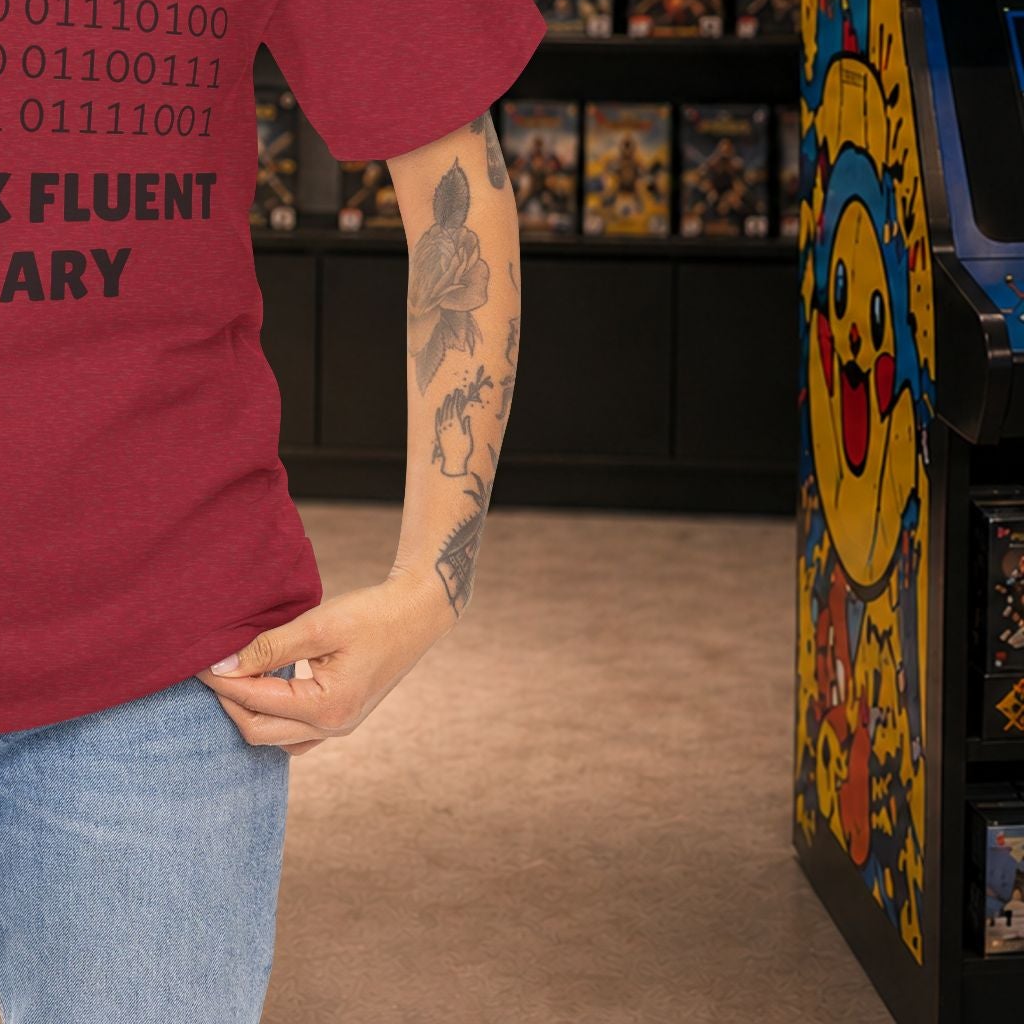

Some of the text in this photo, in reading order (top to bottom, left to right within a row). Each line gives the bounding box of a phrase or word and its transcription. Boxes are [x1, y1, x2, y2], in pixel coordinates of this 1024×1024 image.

[22, 45, 219, 88] 01100111
[20, 98, 211, 136] 01111001
[30, 172, 217, 223] FLUENT
